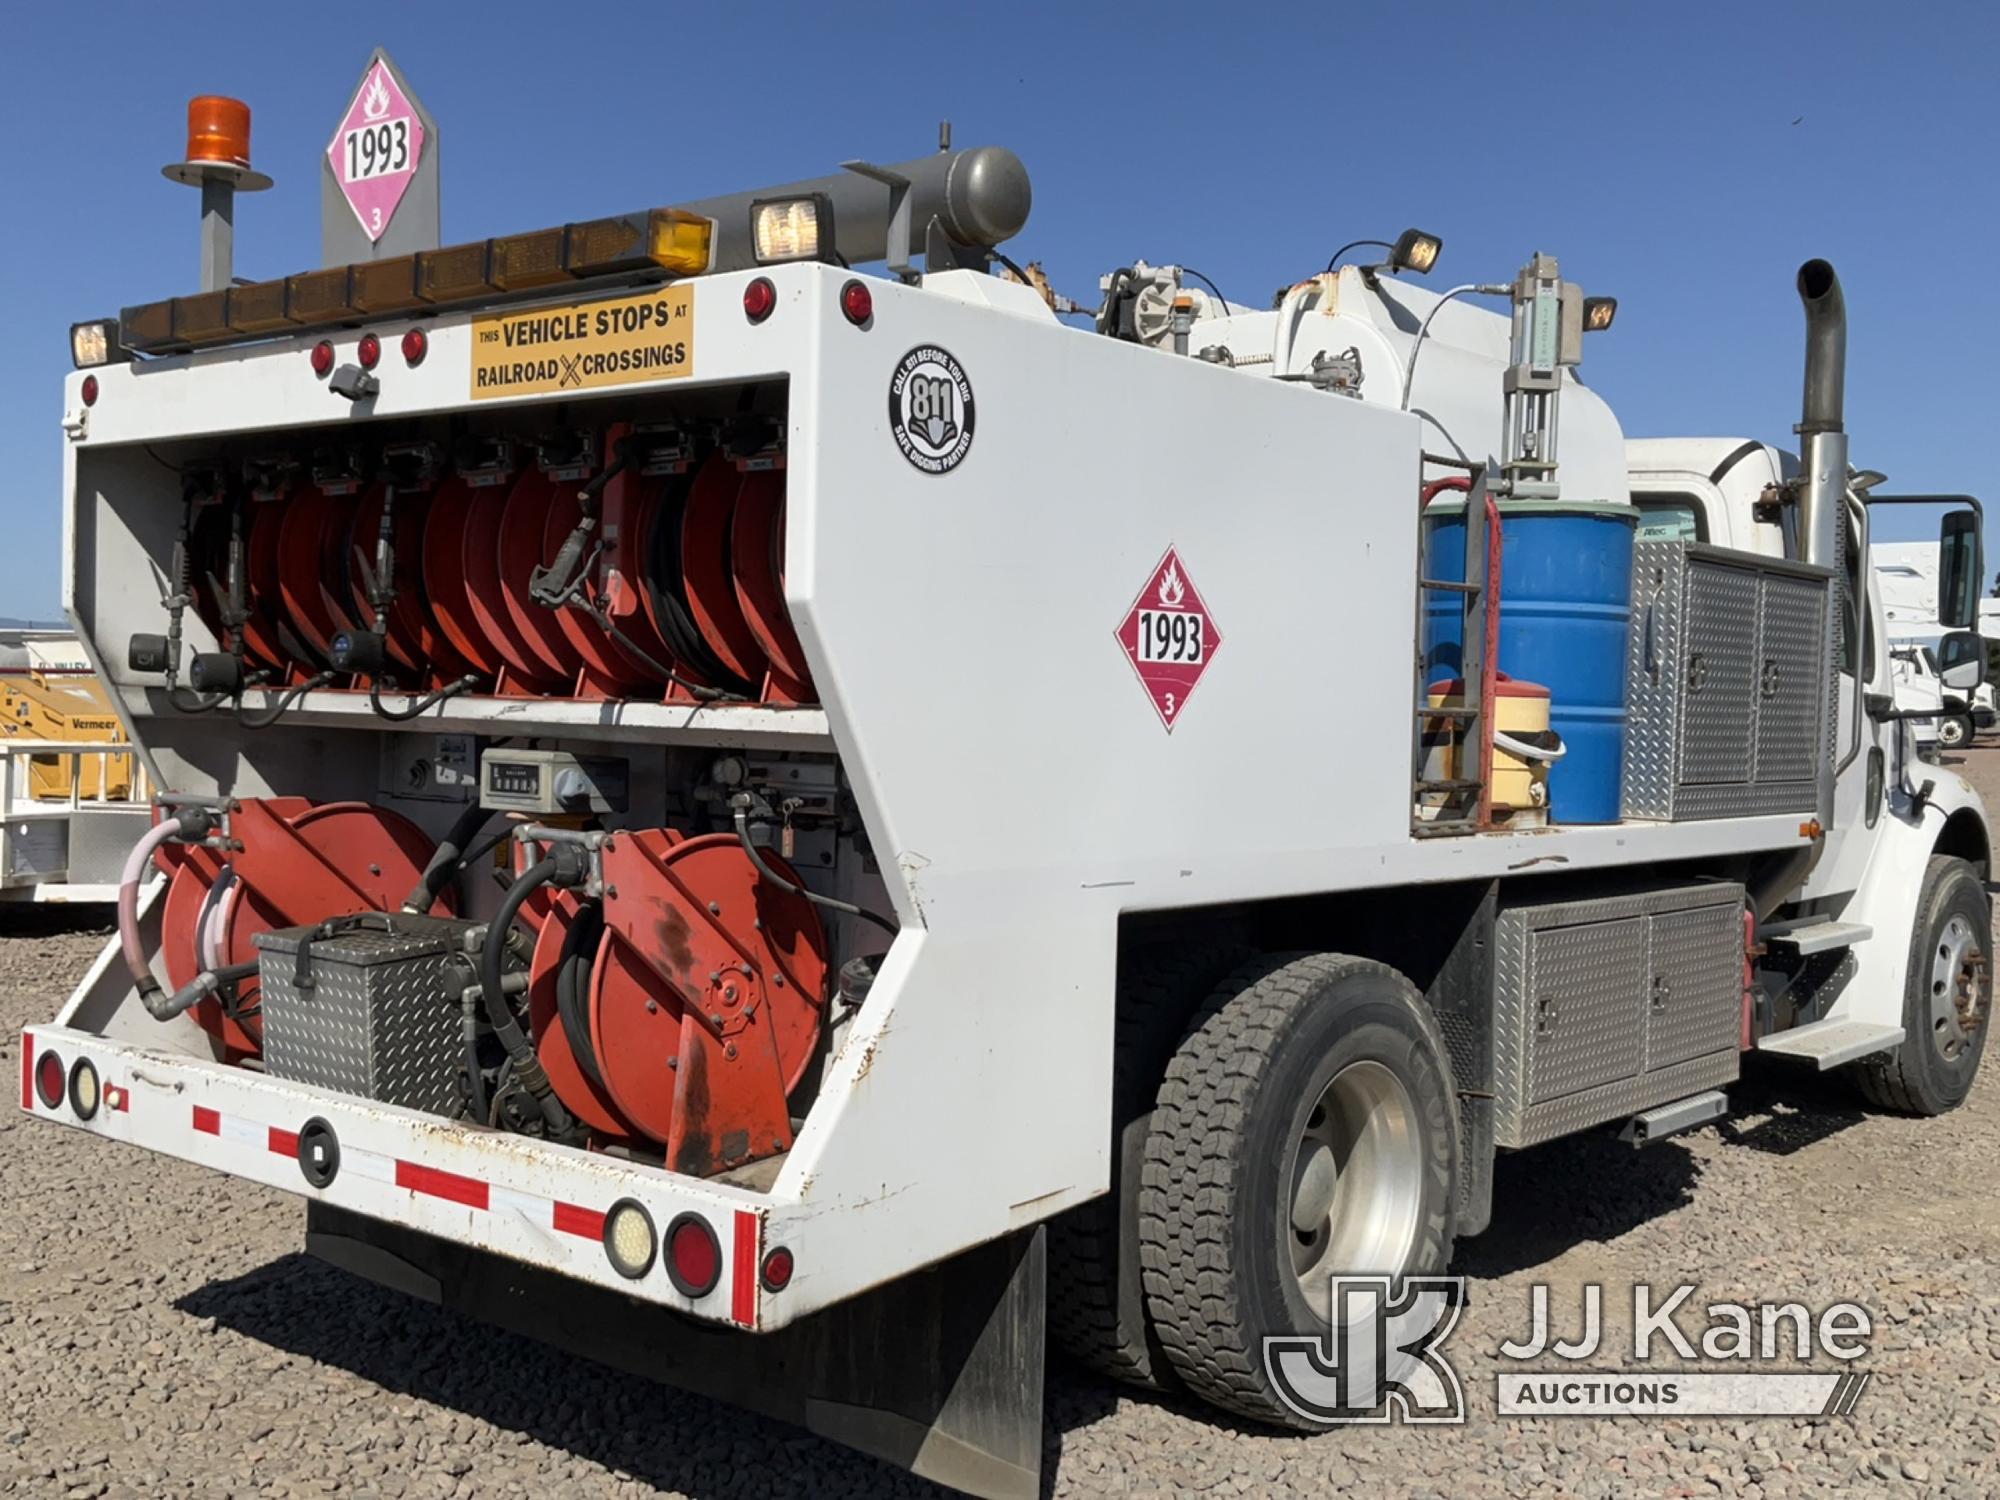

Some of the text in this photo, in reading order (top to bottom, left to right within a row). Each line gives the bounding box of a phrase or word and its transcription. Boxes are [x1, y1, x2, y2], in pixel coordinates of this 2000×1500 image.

[347, 121, 407, 178] 1993
[371, 207, 382, 231] 3
[479, 300, 688, 347] THIS VEHICLE STOPS AT
[477, 342, 686, 387] RAILROAD CROSSINGS
[893, 368, 909, 395] CALL
[916, 349, 949, 366] BEFORE
[948, 360, 963, 382] YOU
[960, 381, 972, 403] DIG
[911, 375, 952, 422] 811
[894, 425, 971, 471] SAFE DIGGING PARTNER
[1141, 612, 1201, 662] 1993
[72, 718, 116, 729] Vermeer
[1164, 692, 1175, 716] 3
